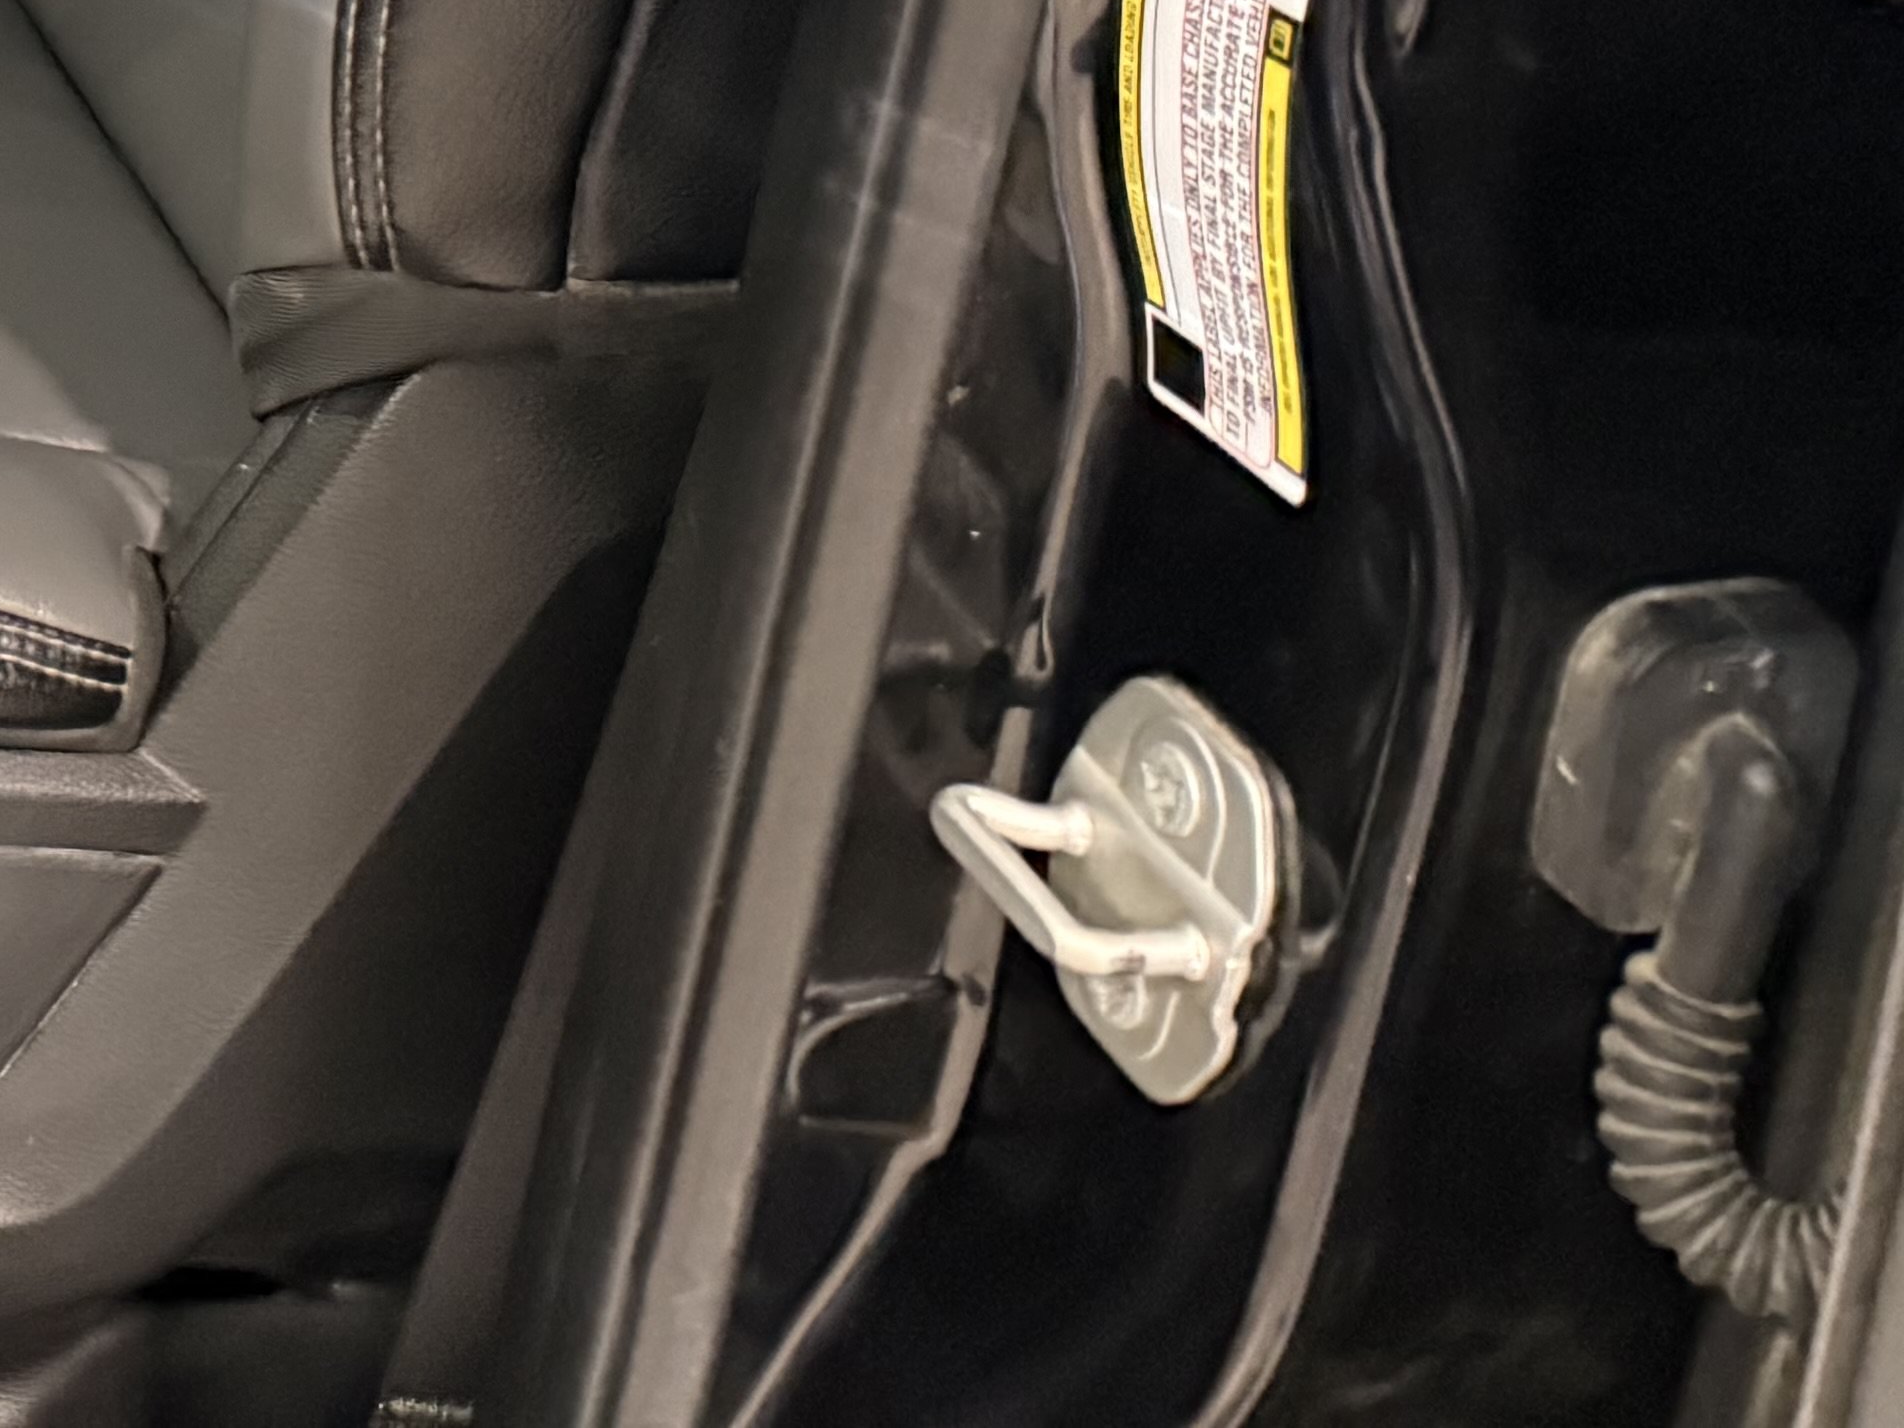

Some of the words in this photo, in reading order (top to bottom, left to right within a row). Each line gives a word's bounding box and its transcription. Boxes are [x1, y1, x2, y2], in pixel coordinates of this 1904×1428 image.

[1221, 4, 1245, 118] ACCURATE
[1182, 66, 1198, 119] BASE
[1236, 52, 1257, 179] COMPLETED
[1201, 119, 1216, 187] STAGE
[1219, 121, 1233, 161] THE
[1183, 162, 1200, 211] ONLY
[1220, 172, 1234, 212] FOR
[1237, 184, 1251, 222] THE
[1204, 196, 1222, 249] FINAL
[1187, 214, 1212, 297] APPLIES
[1210, 256, 1225, 283] BY
[1241, 230, 1256, 272] FOR
[1222, 216, 1249, 349] RESPONSIBLE
[1203, 302, 1222, 362] LABEL
[1215, 288, 1234, 345] UPFIT
[1239, 351, 1252, 374] IS
[1246, 278, 1272, 416] INFORMATION
[1208, 363, 1224, 410] THIS
[1222, 350, 1239, 407] FINAL
[1240, 378, 1256, 424] FSM
[1226, 412, 1240, 440] TO
